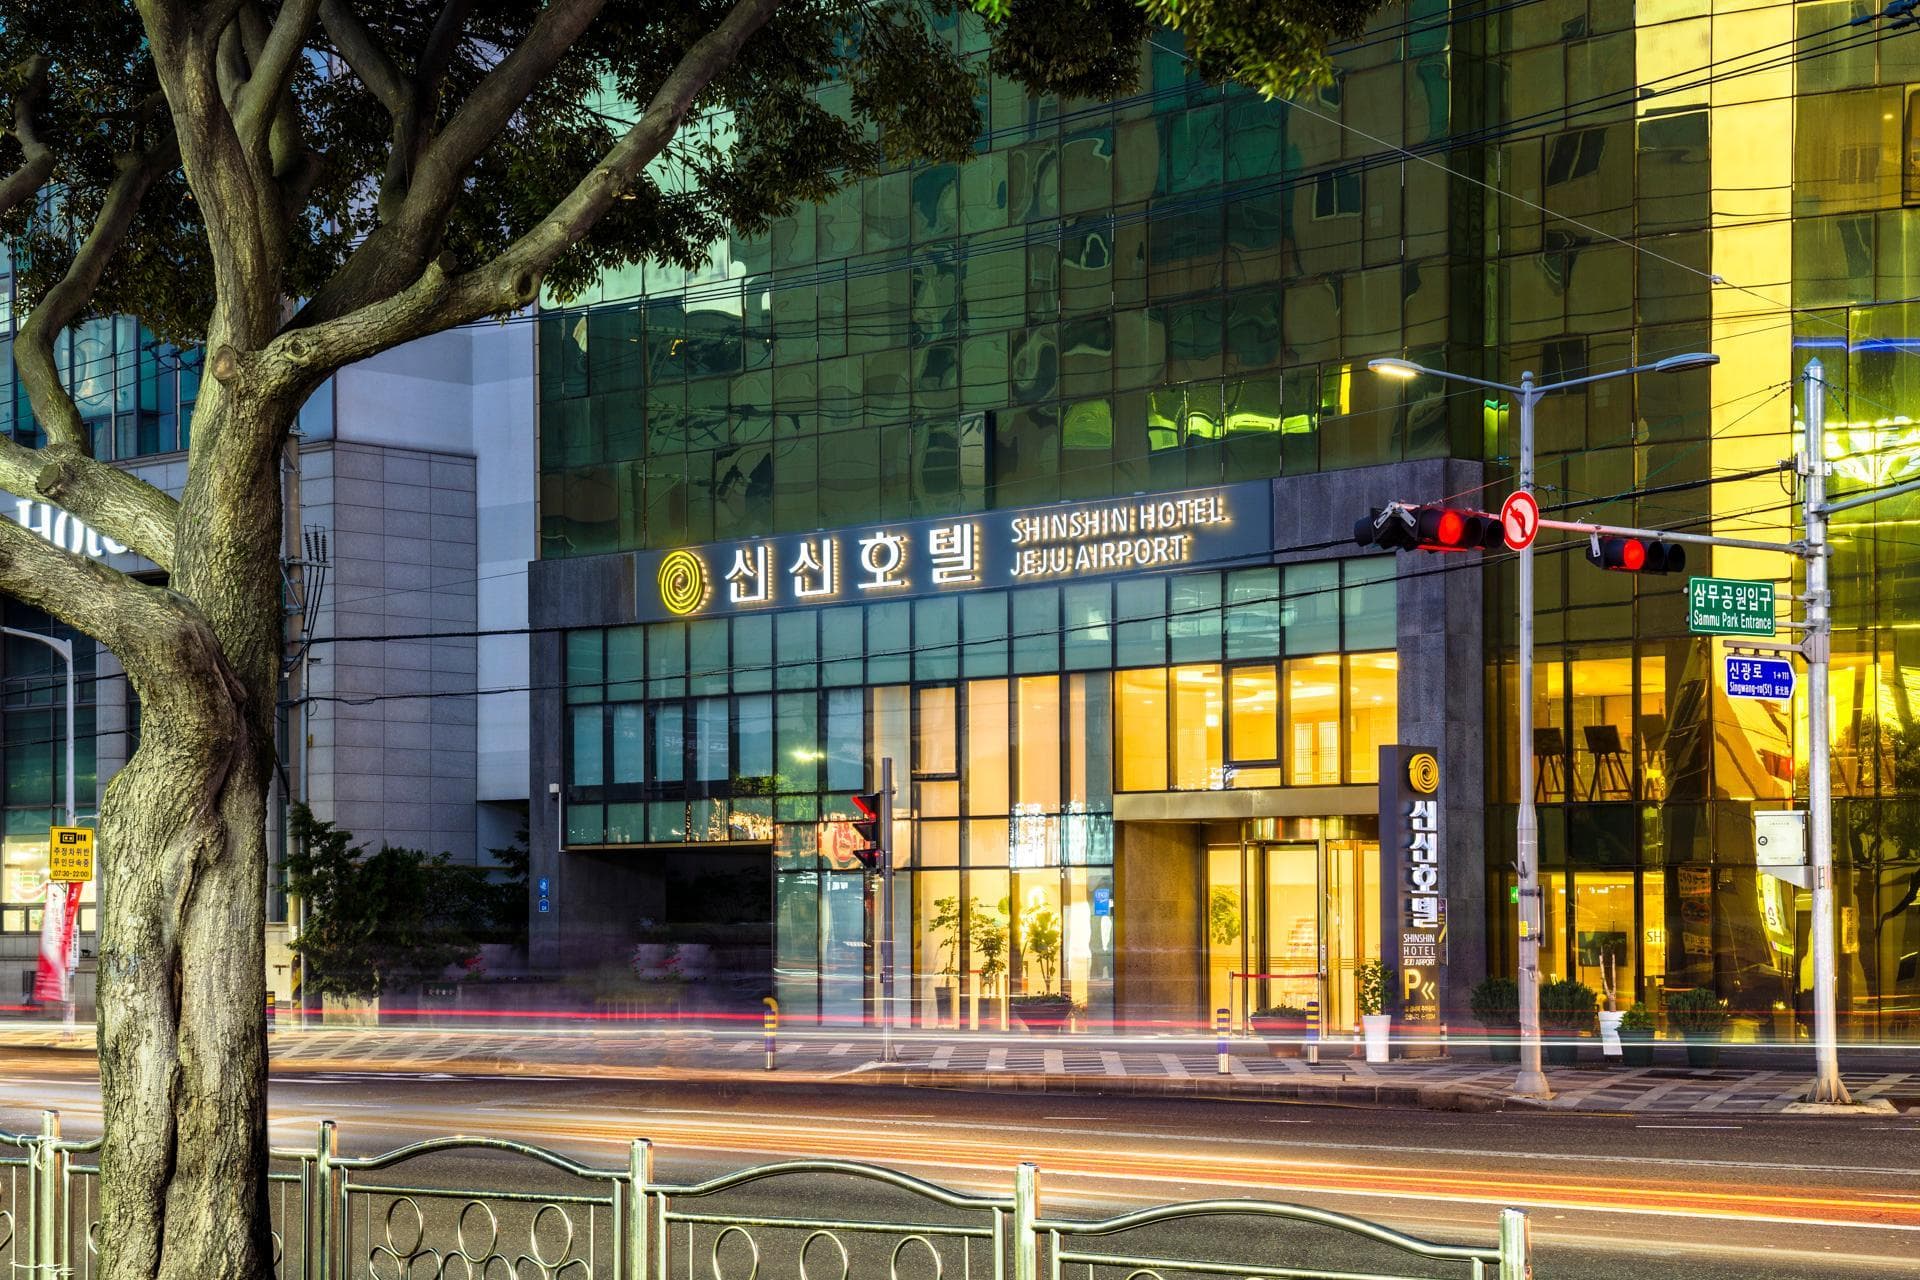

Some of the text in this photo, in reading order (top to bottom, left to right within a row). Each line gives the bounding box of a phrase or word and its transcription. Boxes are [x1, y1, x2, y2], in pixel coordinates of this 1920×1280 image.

[1011, 496, 1223, 543] SHINSHIN HOTEL
[724, 523, 975, 603] 신신호텔
[1010, 534, 1185, 576] JEJU AIRPORT
[1694, 584, 1772, 612] 삼무공원입구
[1693, 609, 1772, 630] Sammu Park Entrance
[1729, 662, 1763, 681] 신광로
[53, 847, 89, 857] 주정차위반
[53, 858, 89, 868] 무인단속중
[1408, 800, 1439, 928] 신신호텔
[1403, 933, 1436, 943] SHINSHIN
[1403, 946, 1436, 956] HOTEL
[1415, 958, 1435, 966] AIRPORT
[1404, 968, 1421, 1000] P
